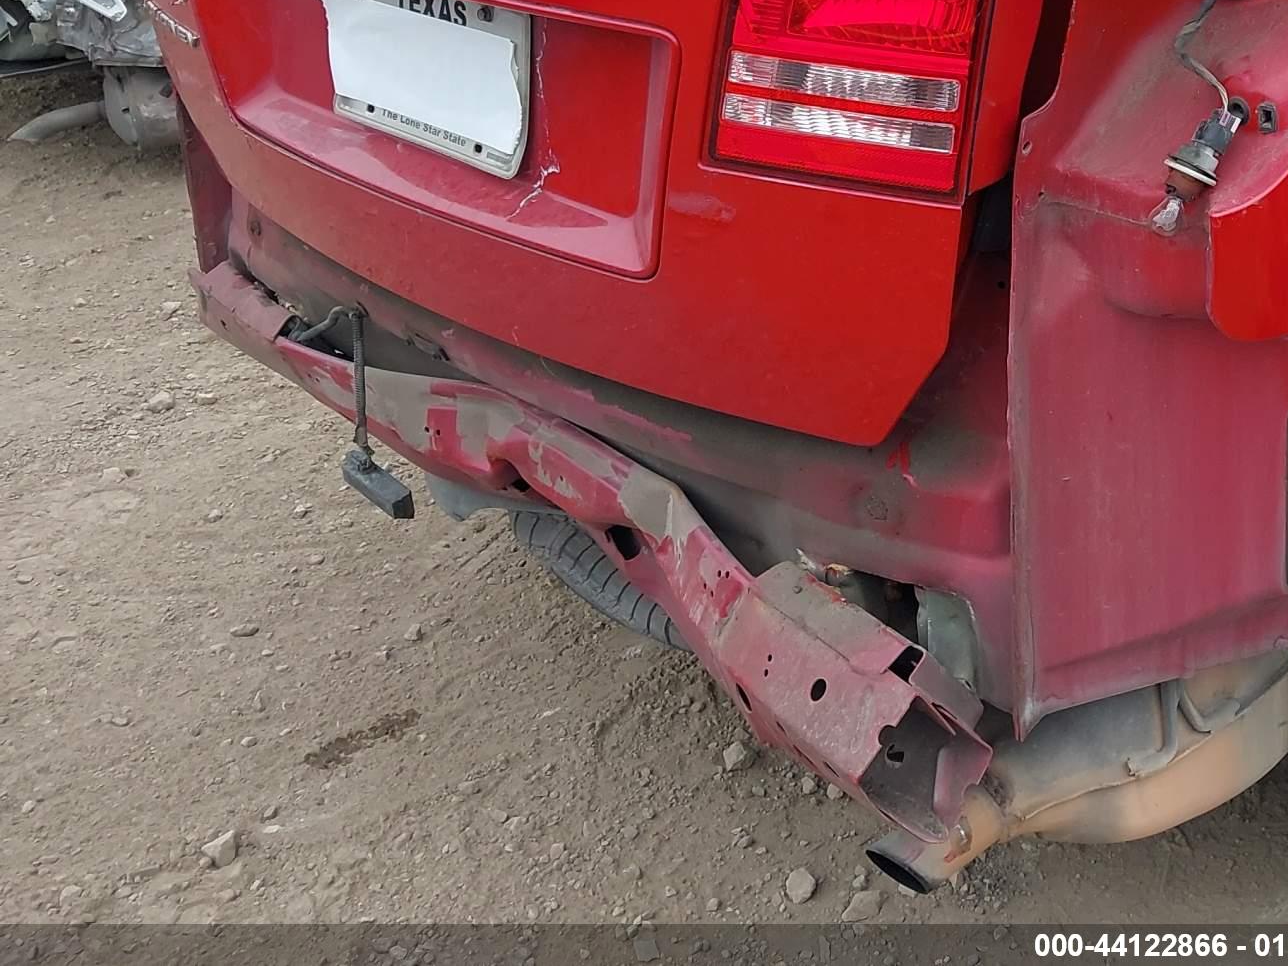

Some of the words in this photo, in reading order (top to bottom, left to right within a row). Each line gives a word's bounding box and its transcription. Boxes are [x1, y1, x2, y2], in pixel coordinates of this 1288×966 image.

[382, 108, 398, 121] The
[400, 115, 421, 129] Lone
[423, 122, 442, 137] Star
[443, 129, 467, 147] State
